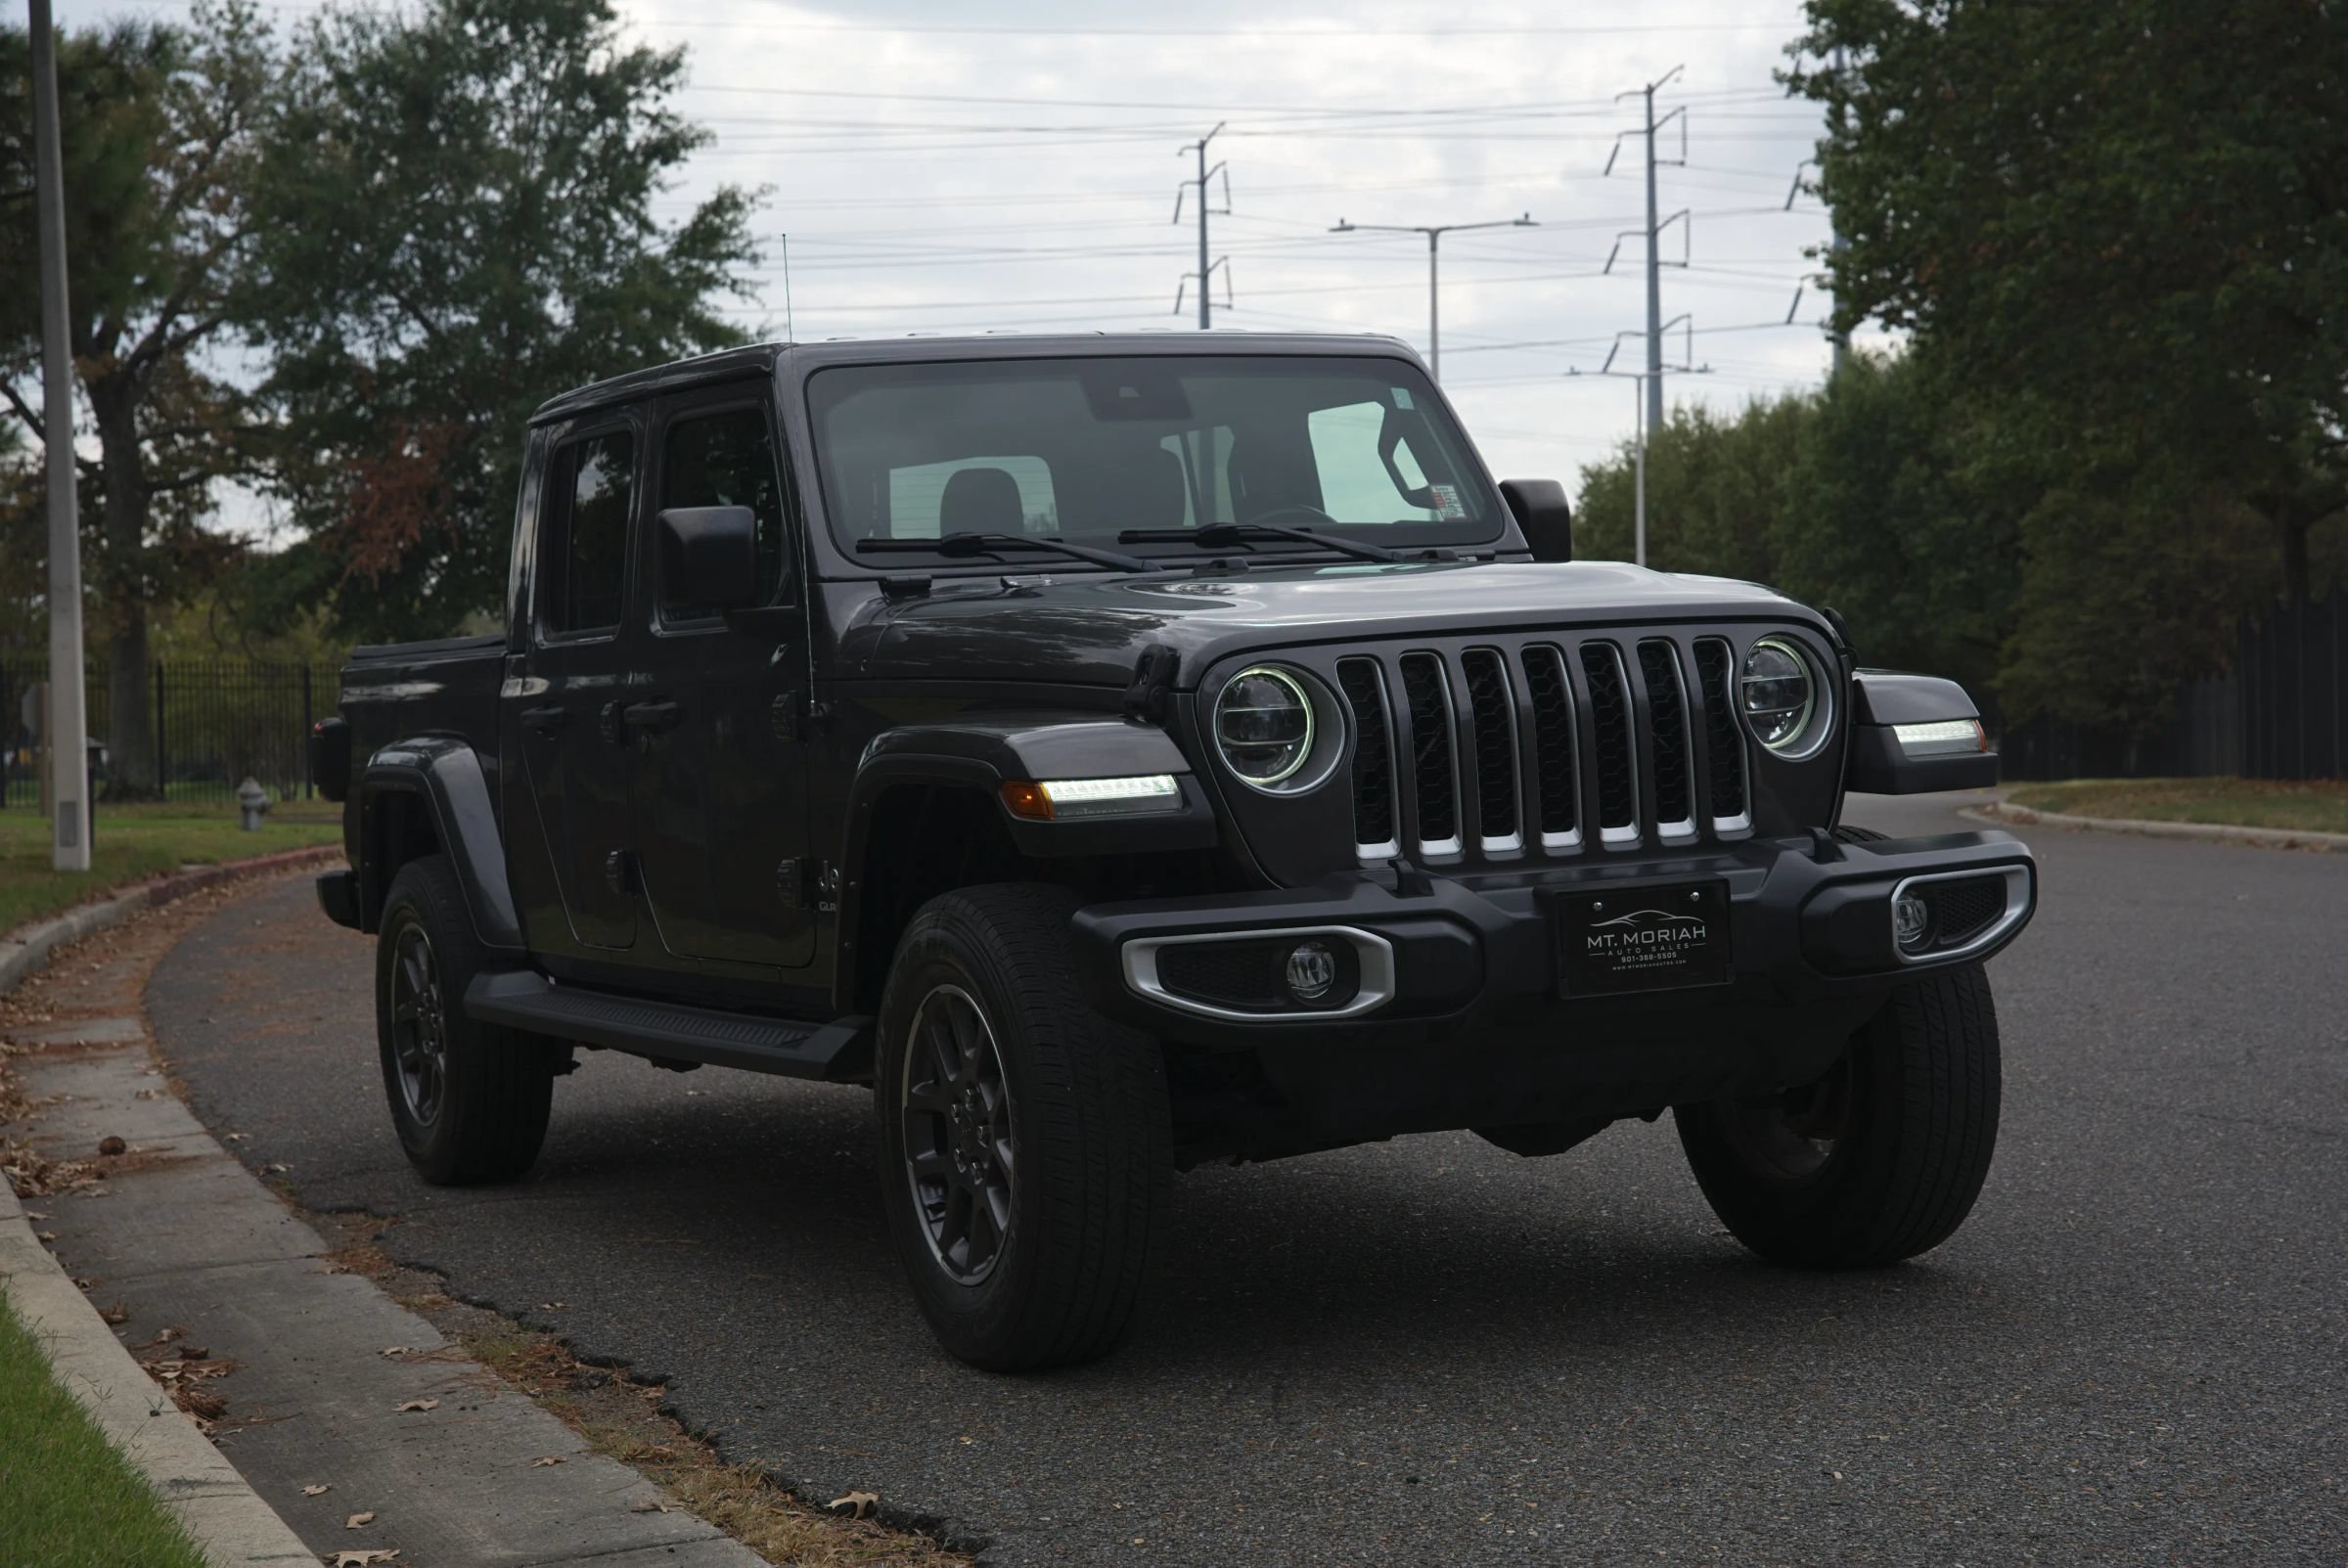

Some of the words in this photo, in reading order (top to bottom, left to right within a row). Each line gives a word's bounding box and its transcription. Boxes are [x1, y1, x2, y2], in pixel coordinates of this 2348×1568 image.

[1587, 934, 1618, 949] MT.
[1623, 925, 1706, 945] MORIAH
[1607, 947, 1642, 956] AUTO
[1651, 942, 1690, 953] SALES
